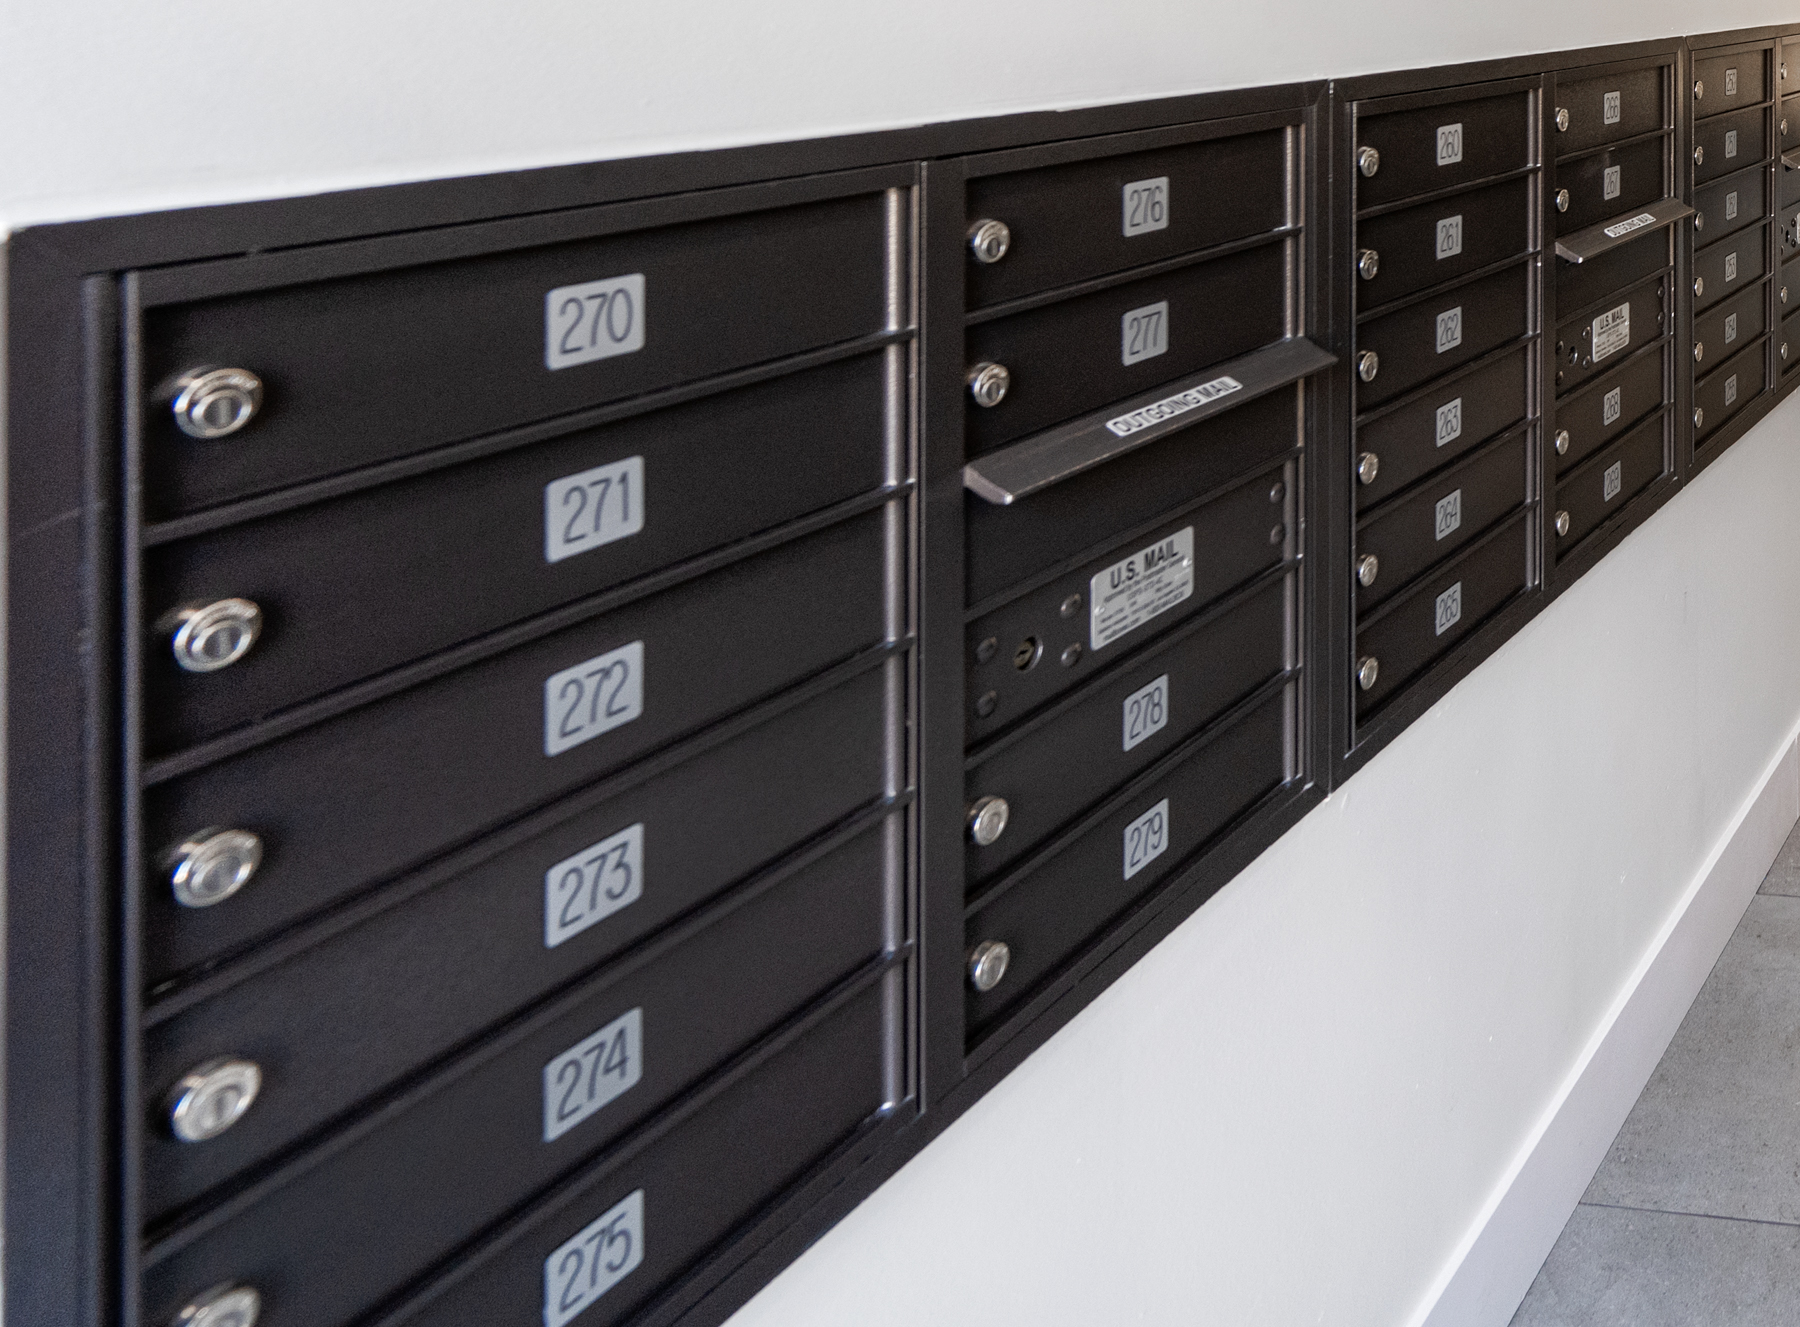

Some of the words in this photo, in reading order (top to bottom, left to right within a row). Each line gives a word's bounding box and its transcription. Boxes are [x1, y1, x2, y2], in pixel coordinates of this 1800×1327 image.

[1605, 96, 1619, 121] 266
[1440, 129, 1461, 160] 260
[1129, 185, 1164, 228] 276
[1605, 170, 1619, 195] 267
[1440, 222, 1460, 253] 261
[559, 287, 634, 357] 270
[1129, 311, 1163, 357] 277
[1440, 313, 1460, 347] 262
[1112, 392, 1202, 433] OUTGOING
[1199, 378, 1239, 402] MAIL
[1439, 405, 1460, 441] 263
[562, 472, 629, 546] 271
[1439, 496, 1459, 534] 264
[1110, 560, 1139, 590] U.S.
[1144, 539, 1179, 573] MAIL
[1439, 589, 1460, 629] 265
[559, 658, 630, 739] 272
[1129, 685, 1164, 742] 278
[1129, 810, 1164, 869] 279
[558, 840, 632, 930] 273
[556, 1026, 631, 1124] 274
[557, 1212, 632, 1315] 275
